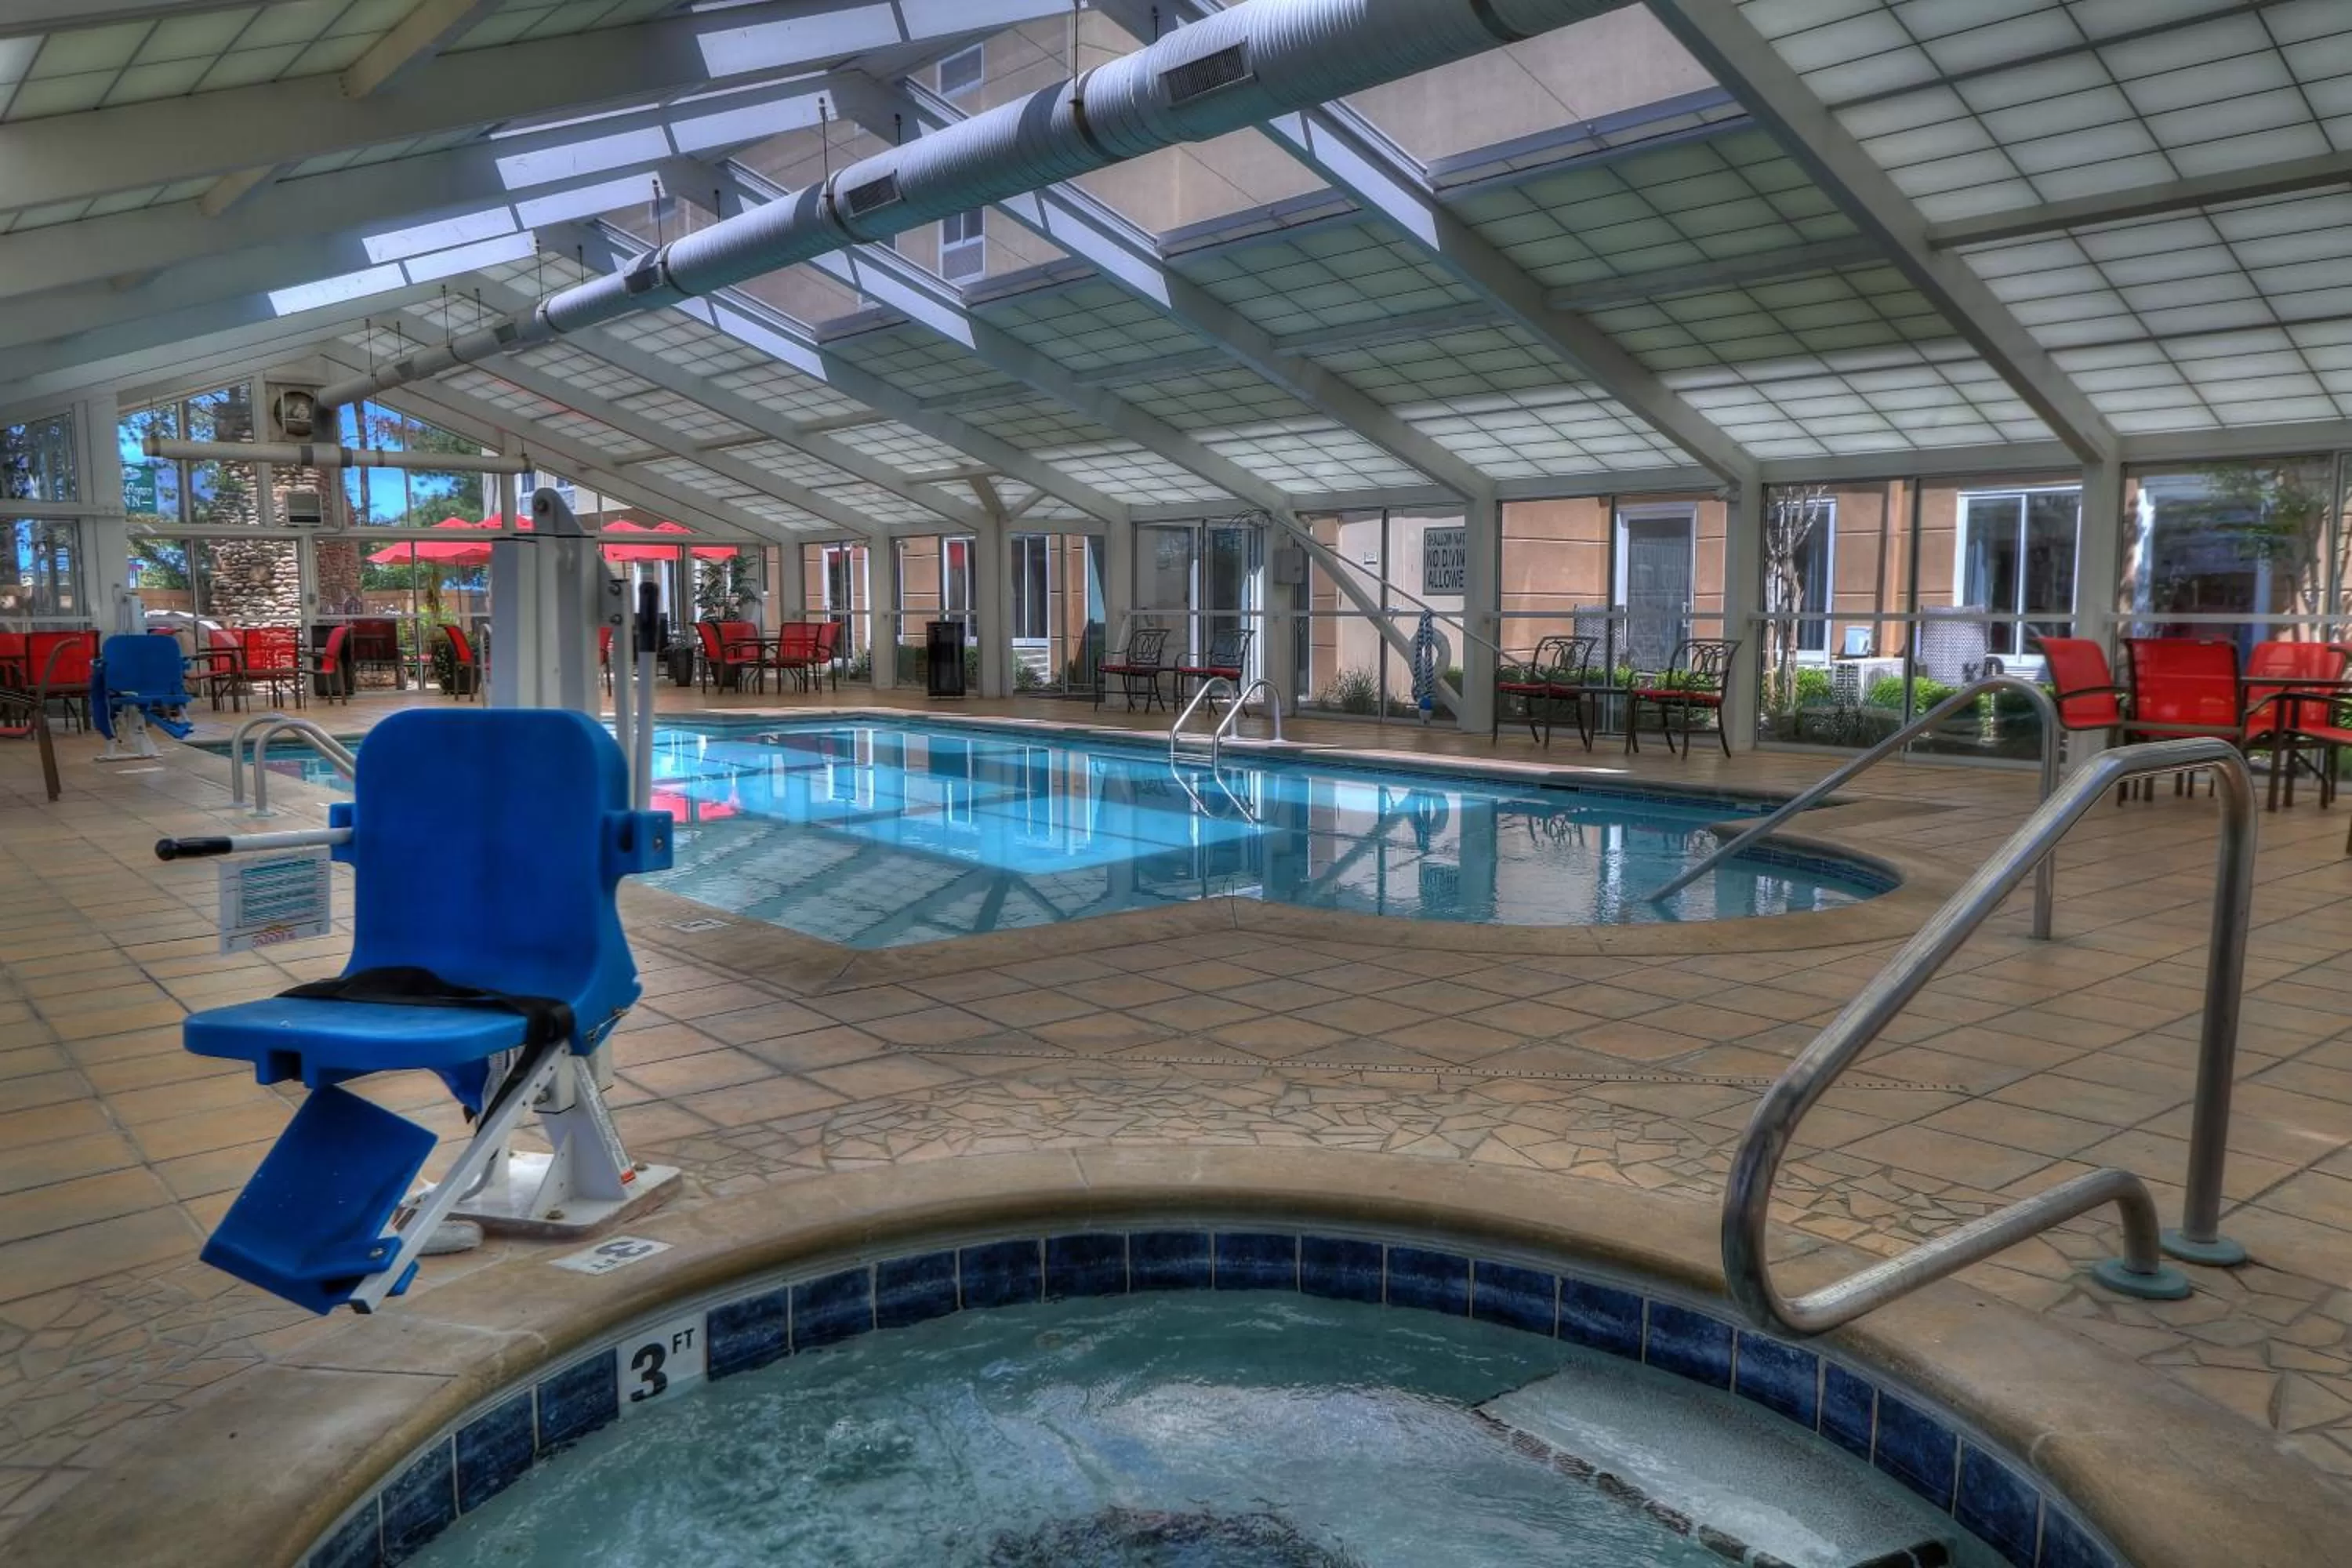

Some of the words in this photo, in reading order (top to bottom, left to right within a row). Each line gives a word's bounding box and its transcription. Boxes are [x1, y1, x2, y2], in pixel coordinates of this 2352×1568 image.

[1427, 550, 1439, 568] NO
[1442, 549, 1465, 567] DIVIN
[1428, 570, 1465, 588] ALLOWE
[593, 1240, 654, 1258] 3
[630, 1341, 669, 1403] 3
[672, 1327, 695, 1355] FT
